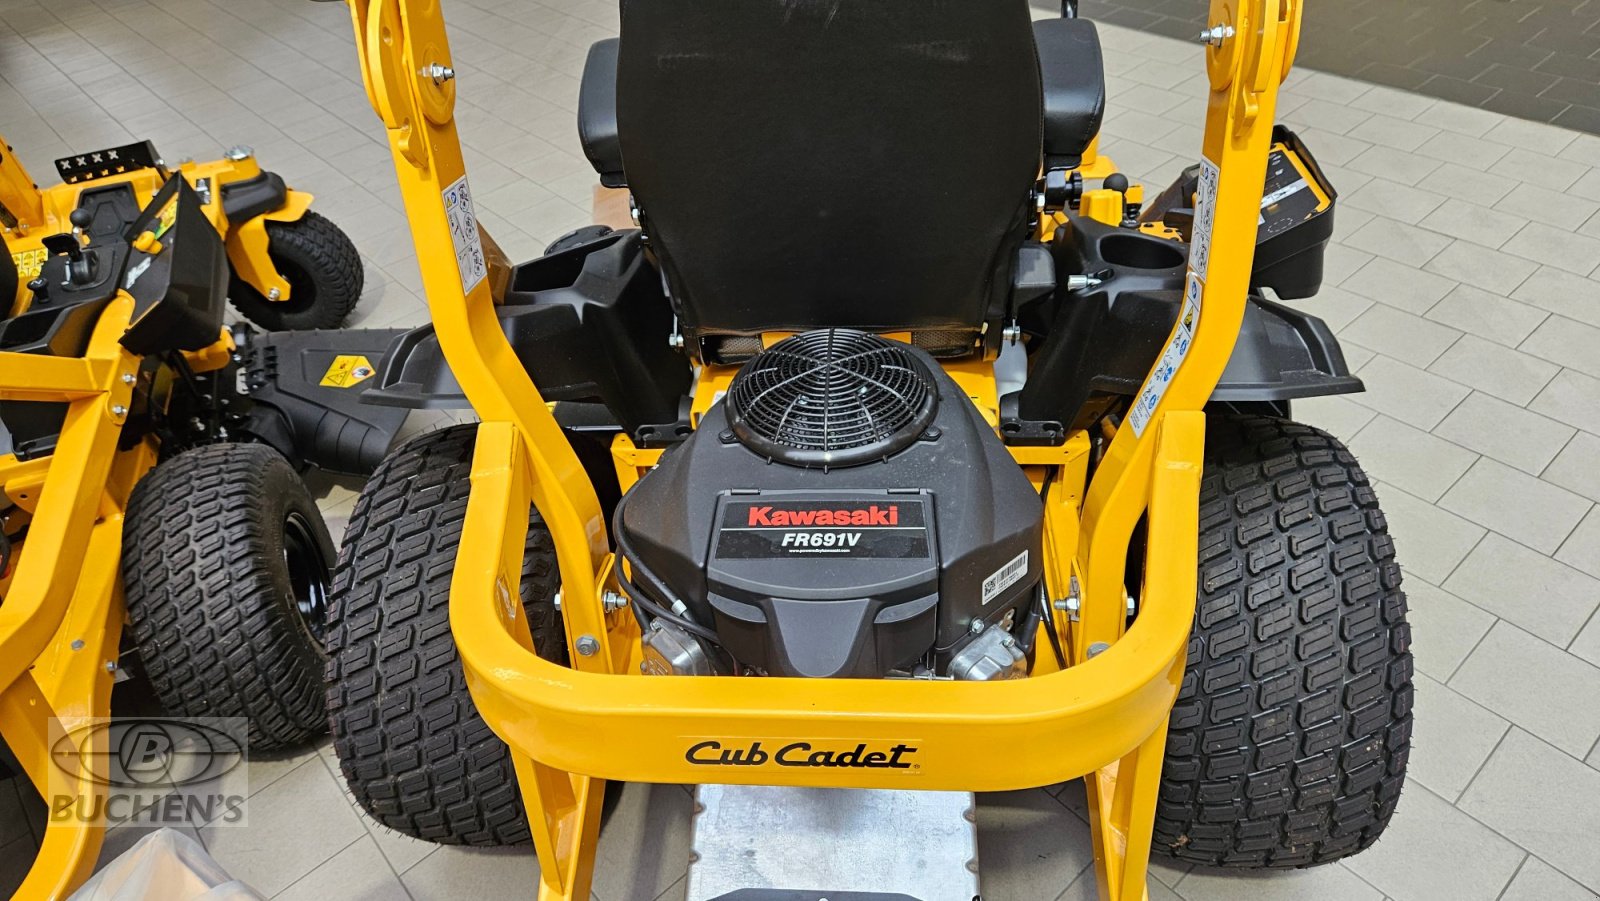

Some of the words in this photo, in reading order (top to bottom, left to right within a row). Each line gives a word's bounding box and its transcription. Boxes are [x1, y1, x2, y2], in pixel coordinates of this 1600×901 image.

[748, 506, 898, 526] Kawasaki
[781, 532, 862, 547] FR691V
[685, 740, 769, 766] Cub
[774, 742, 918, 768] Cadet
